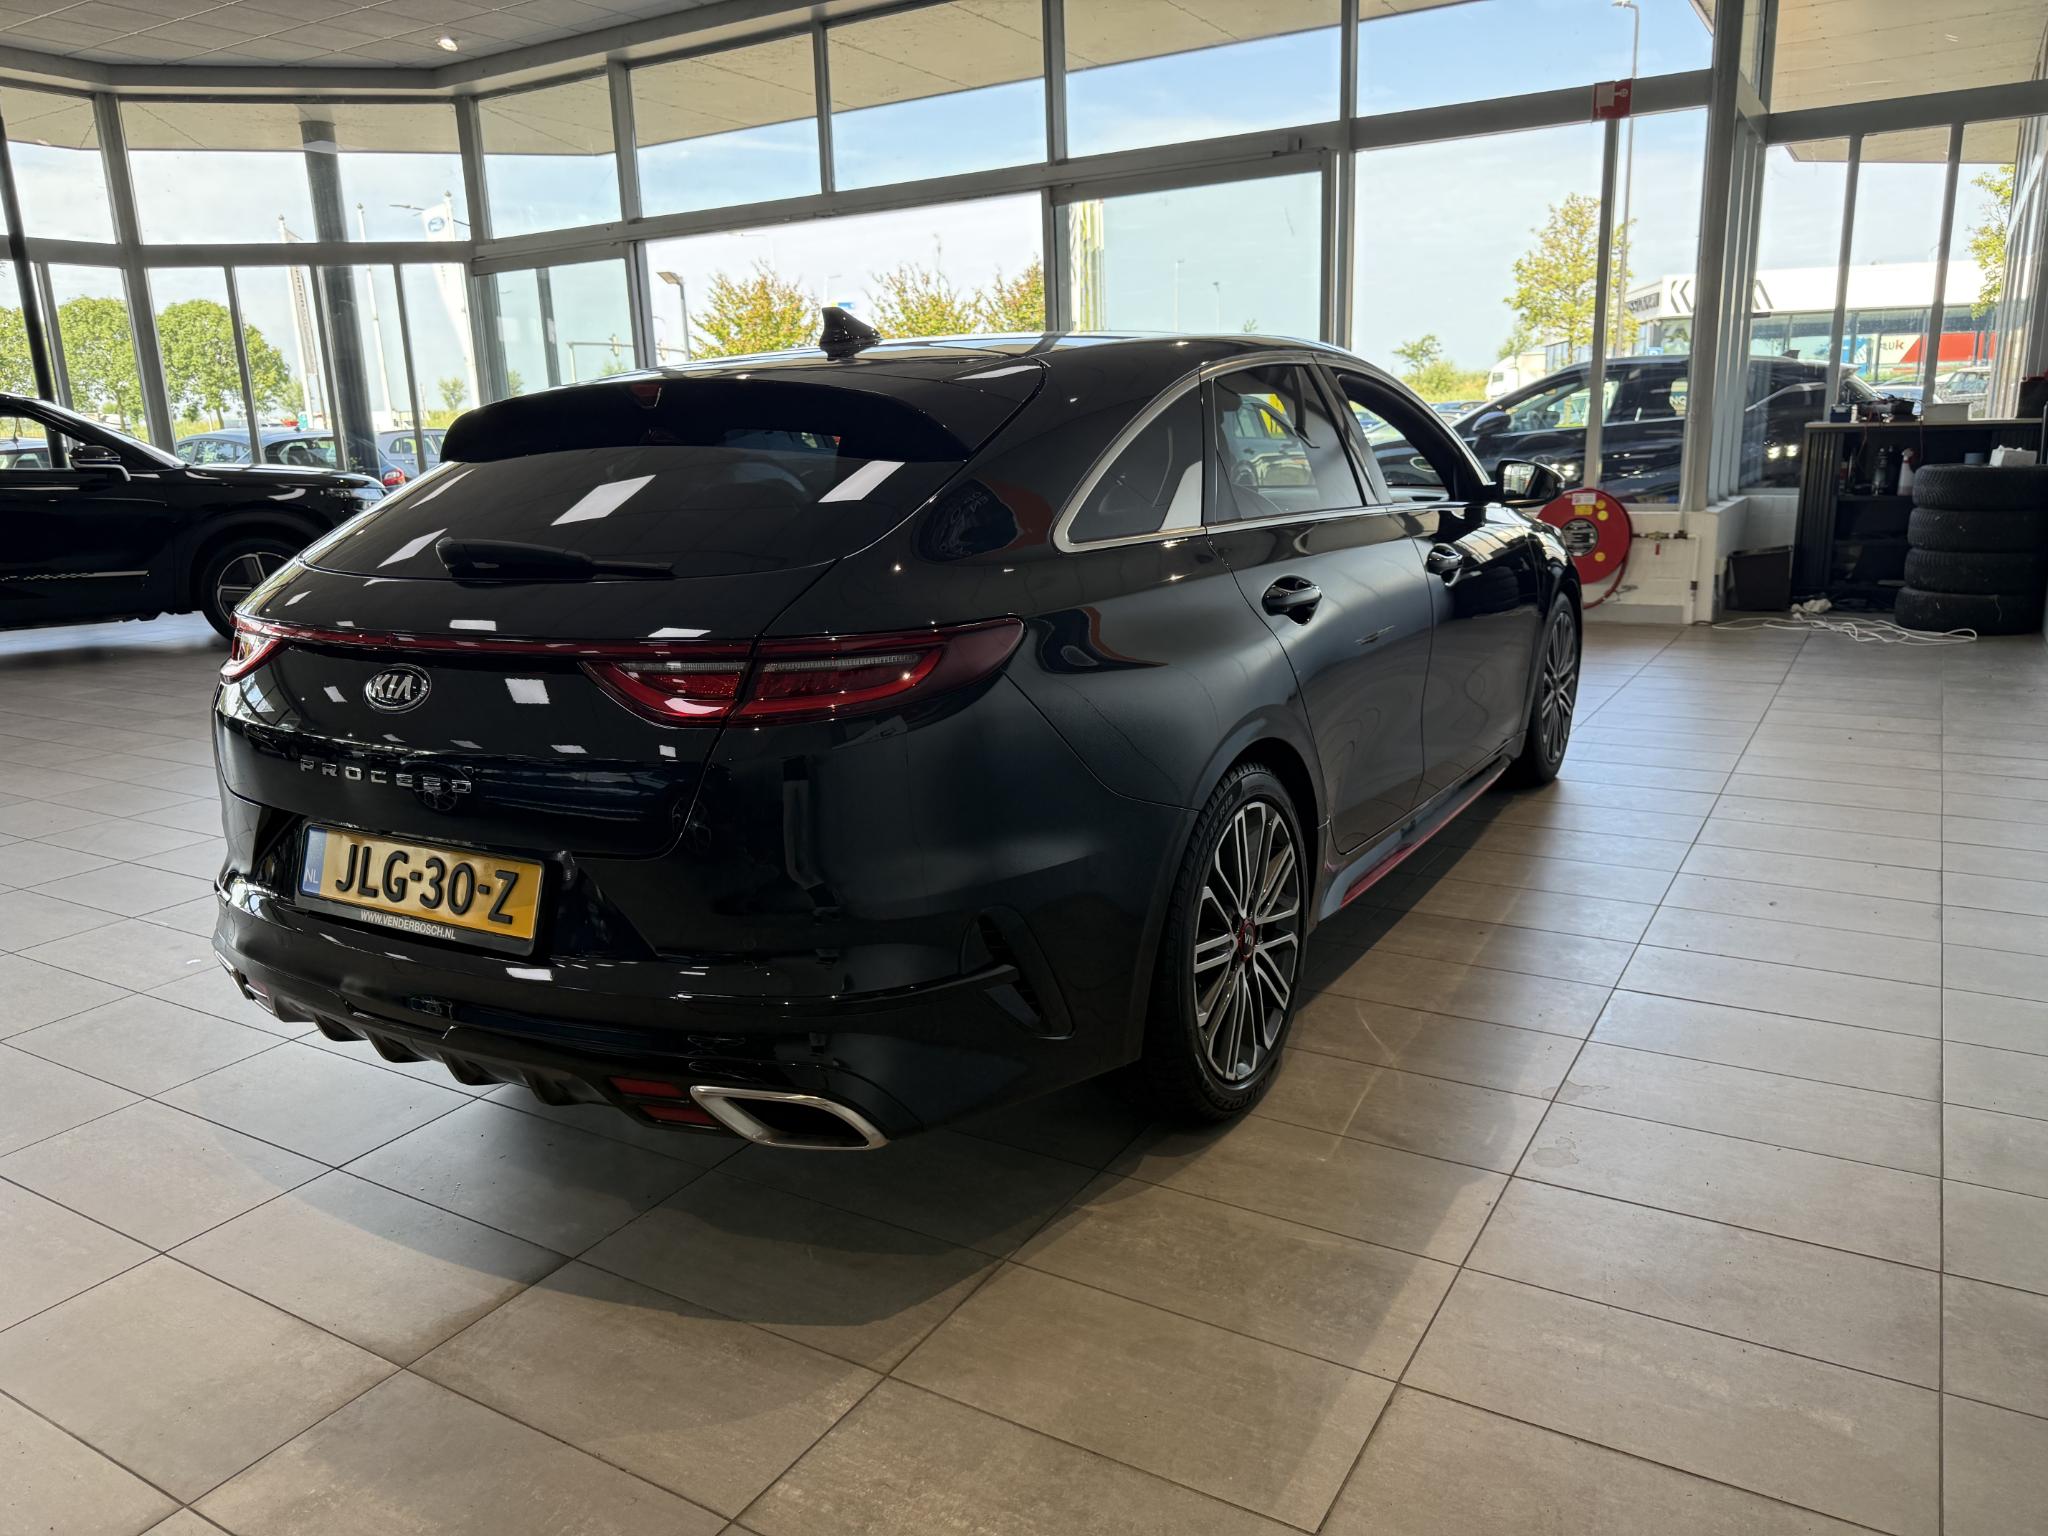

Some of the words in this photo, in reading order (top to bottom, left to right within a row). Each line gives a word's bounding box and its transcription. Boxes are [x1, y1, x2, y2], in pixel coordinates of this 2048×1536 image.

[371, 673, 415, 701] KIA
[299, 757, 473, 794] PROCEED
[304, 867, 319, 884] NL
[335, 843, 519, 925] JLG-30-Z
[360, 909, 457, 940] WWW.VENDERBOSCH.NL
